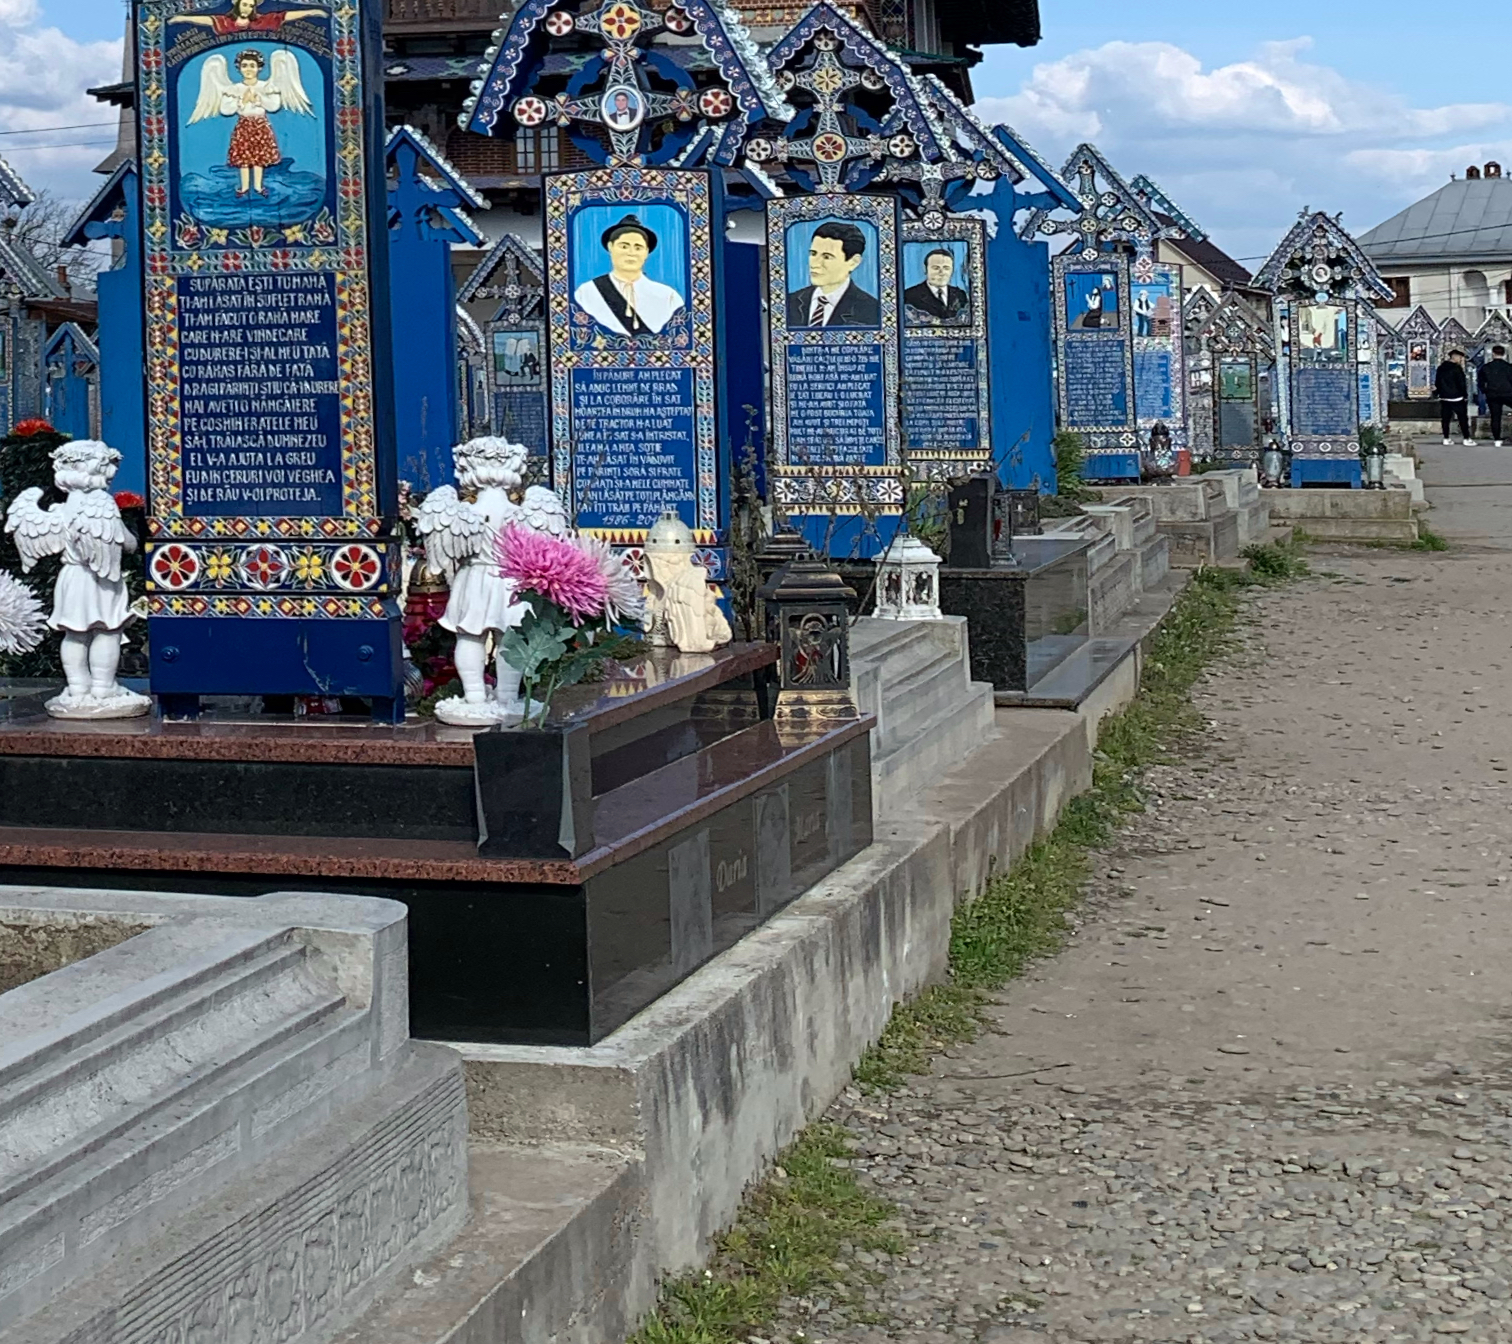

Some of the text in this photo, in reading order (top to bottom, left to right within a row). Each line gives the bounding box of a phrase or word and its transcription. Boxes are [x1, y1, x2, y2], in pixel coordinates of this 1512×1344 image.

[275, 276, 291, 290] TU
[256, 293, 297, 307] SUFLET
[248, 312, 257, 325] O
[290, 310, 321, 324] MARE
[181, 328, 308, 344] CARE N-ARE VINDECARE
[184, 347, 198, 361] CU
[278, 345, 300, 360] MEU
[268, 364, 283, 378] DE
[183, 382, 219, 396] DRAGI
[184, 399, 205, 414] MAI
[240, 399, 249, 413] O
[664, 394, 682, 405] SAT
[183, 417, 198, 432] PE
[244, 417, 292, 430] FRATELE
[266, 434, 327, 448] DUMNEZEU
[190, 452, 204, 466] EL
[227, 452, 264, 465] AJUTA
[266, 452, 284, 466] LA
[285, 452, 316, 466] GREU
[185, 469, 336, 484] EU DIN CERURI VOI VEGHEA
[200, 487, 215, 502] DE
